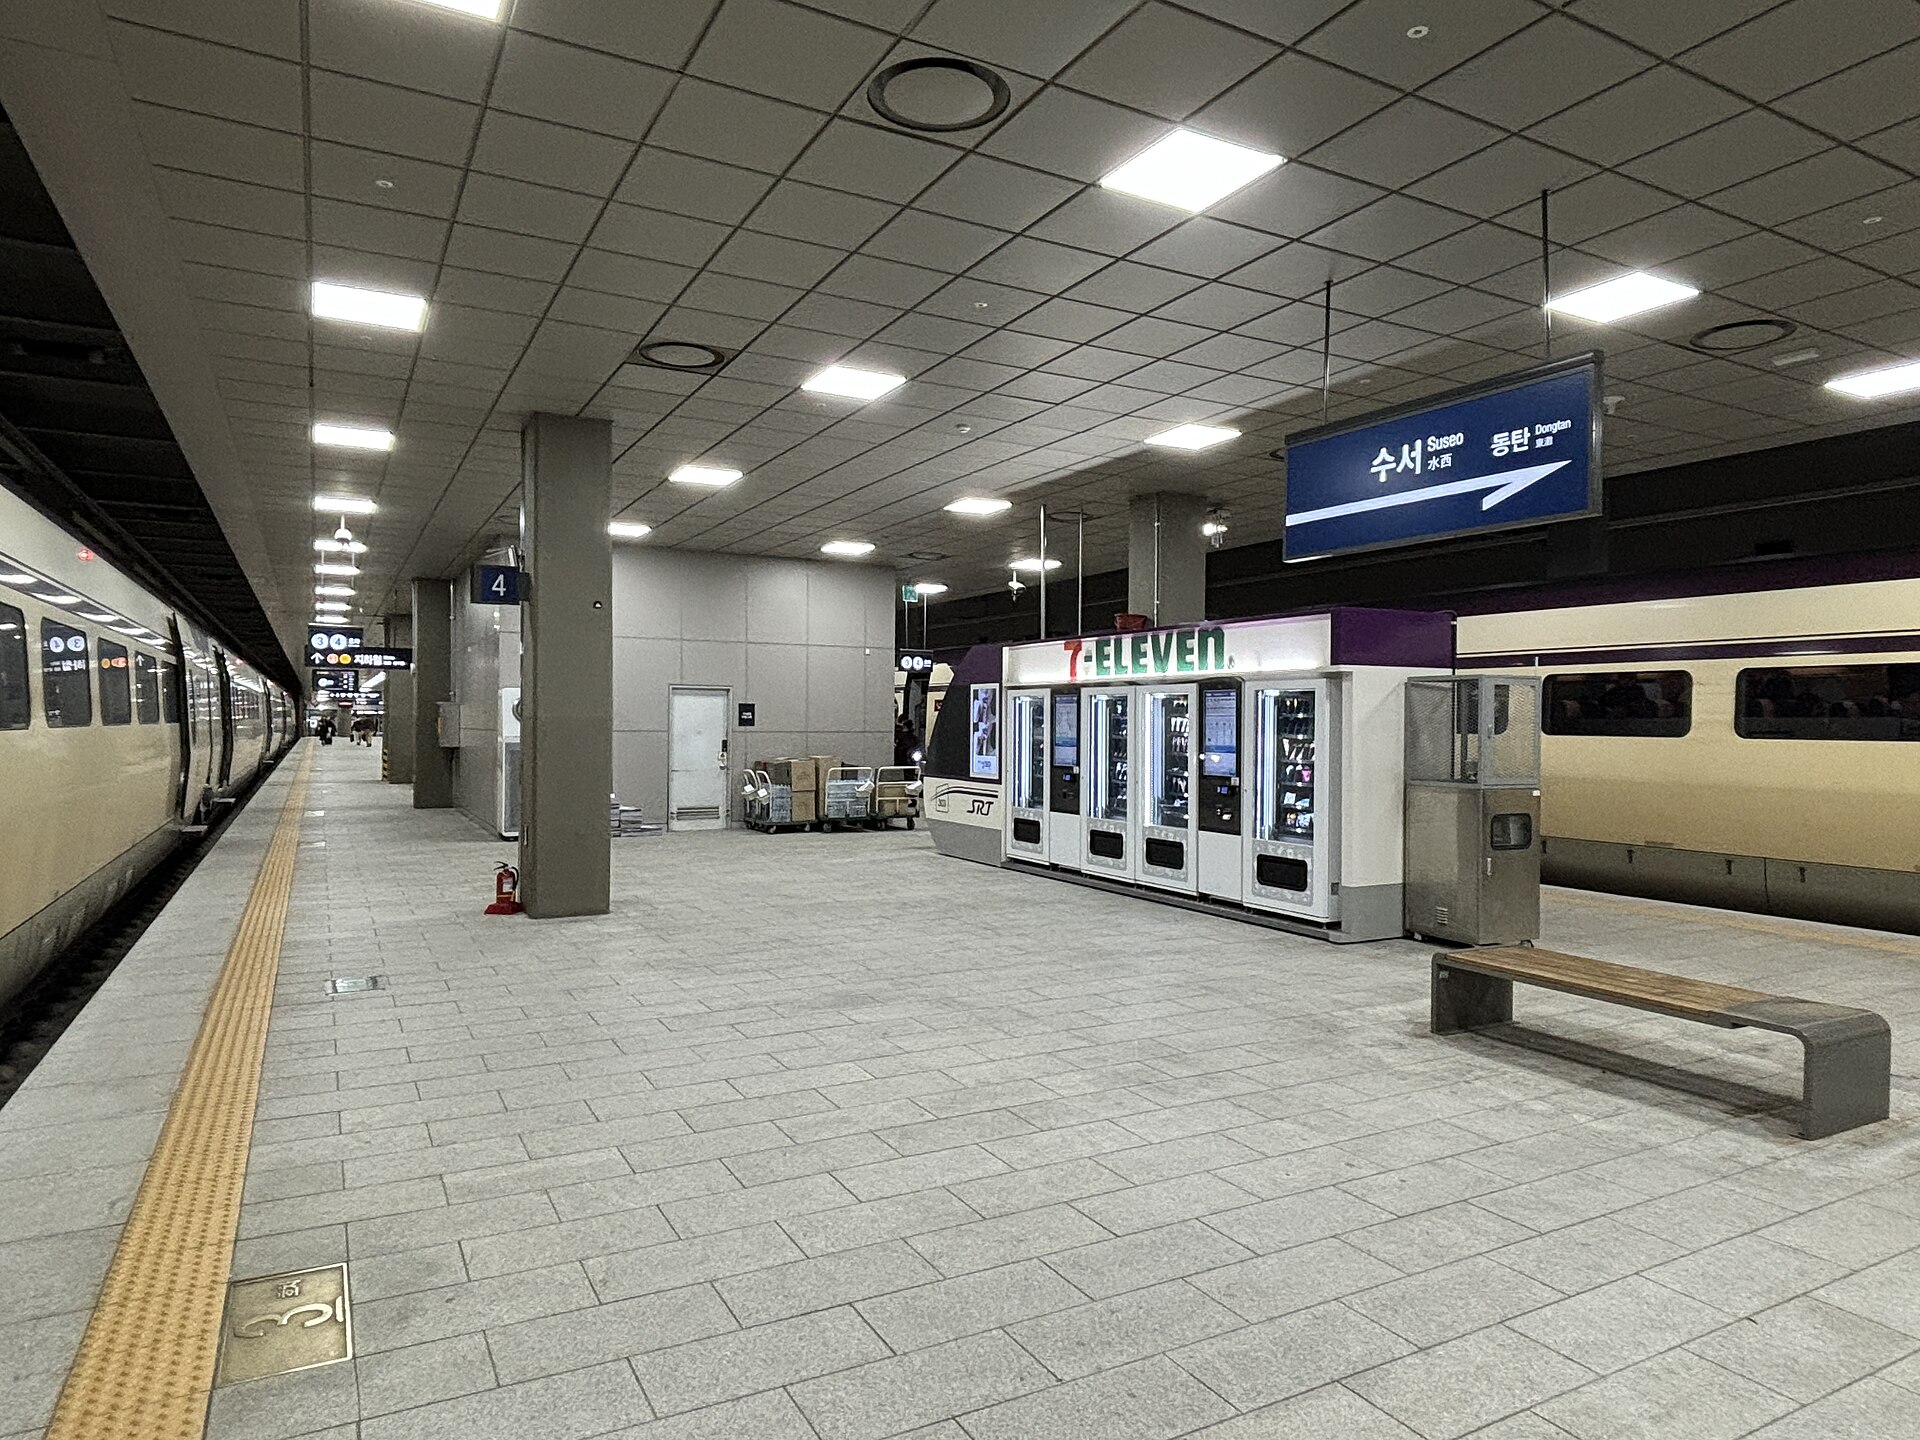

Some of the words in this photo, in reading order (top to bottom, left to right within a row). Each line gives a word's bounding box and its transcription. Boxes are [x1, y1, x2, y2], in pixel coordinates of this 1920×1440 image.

[1535, 419, 1572, 436] Dongtan
[1427, 432, 1464, 451] Suseo
[1490, 426, 1531, 457] 동탄
[1370, 439, 1422, 483] 수서
[1427, 453, 1452, 471] 水西
[491, 573, 506, 597] 4
[966, 799, 994, 816] SRT
[232, 1302, 334, 1339] 3
